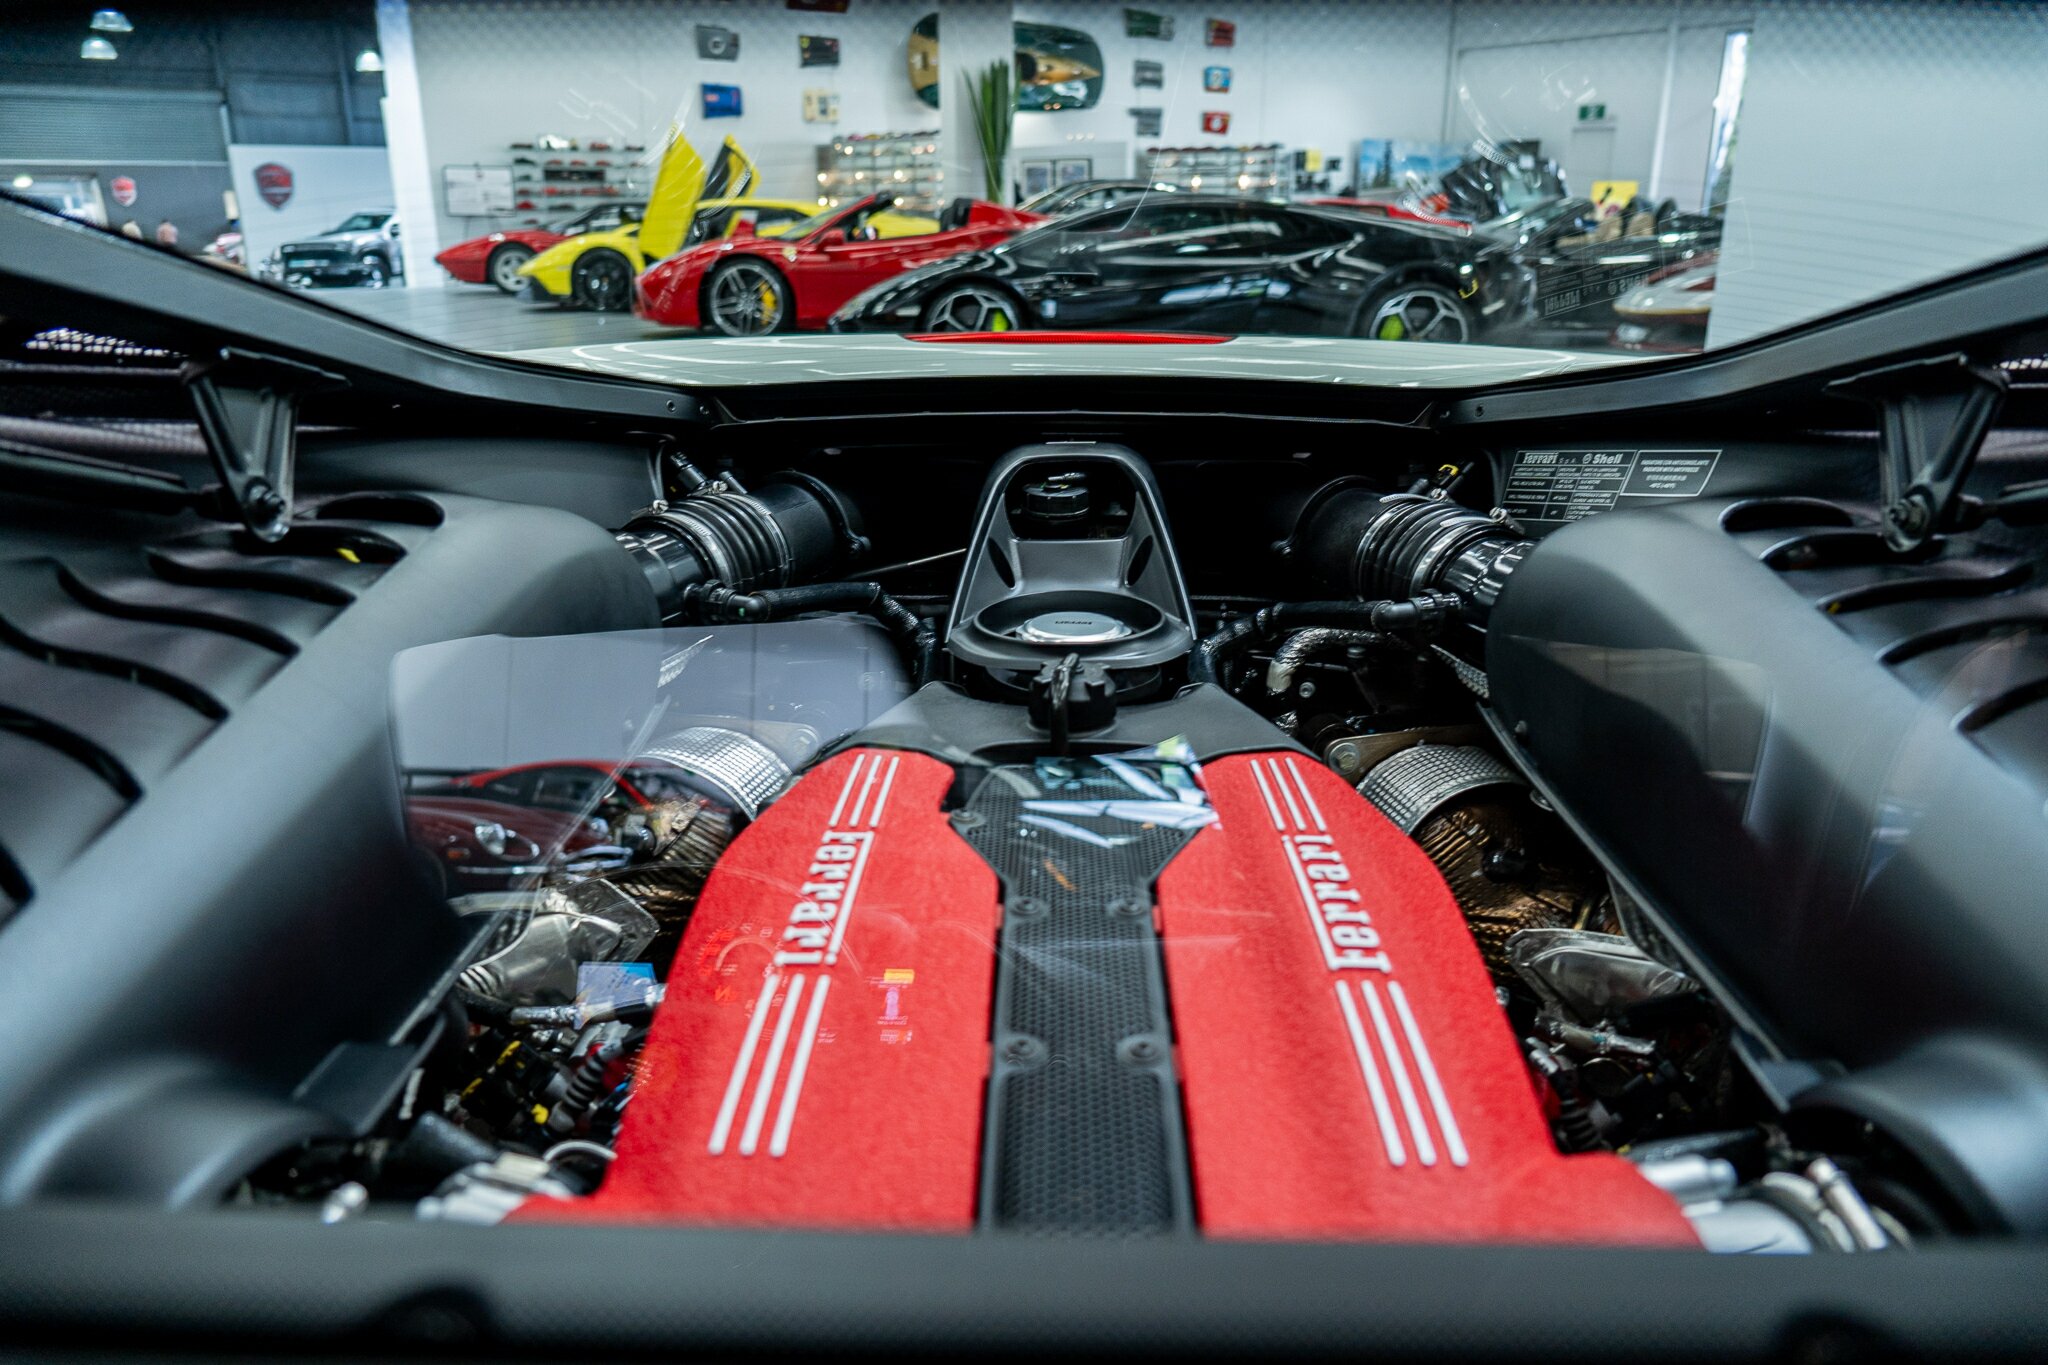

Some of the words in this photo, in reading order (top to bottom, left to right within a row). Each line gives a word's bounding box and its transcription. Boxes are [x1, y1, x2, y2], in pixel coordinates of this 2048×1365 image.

[1522, 452, 1559, 464] Ferrari
[1592, 453, 1624, 464] Shell
[774, 830, 875, 966] Ferrari
[1281, 834, 1392, 974] Ferrari
